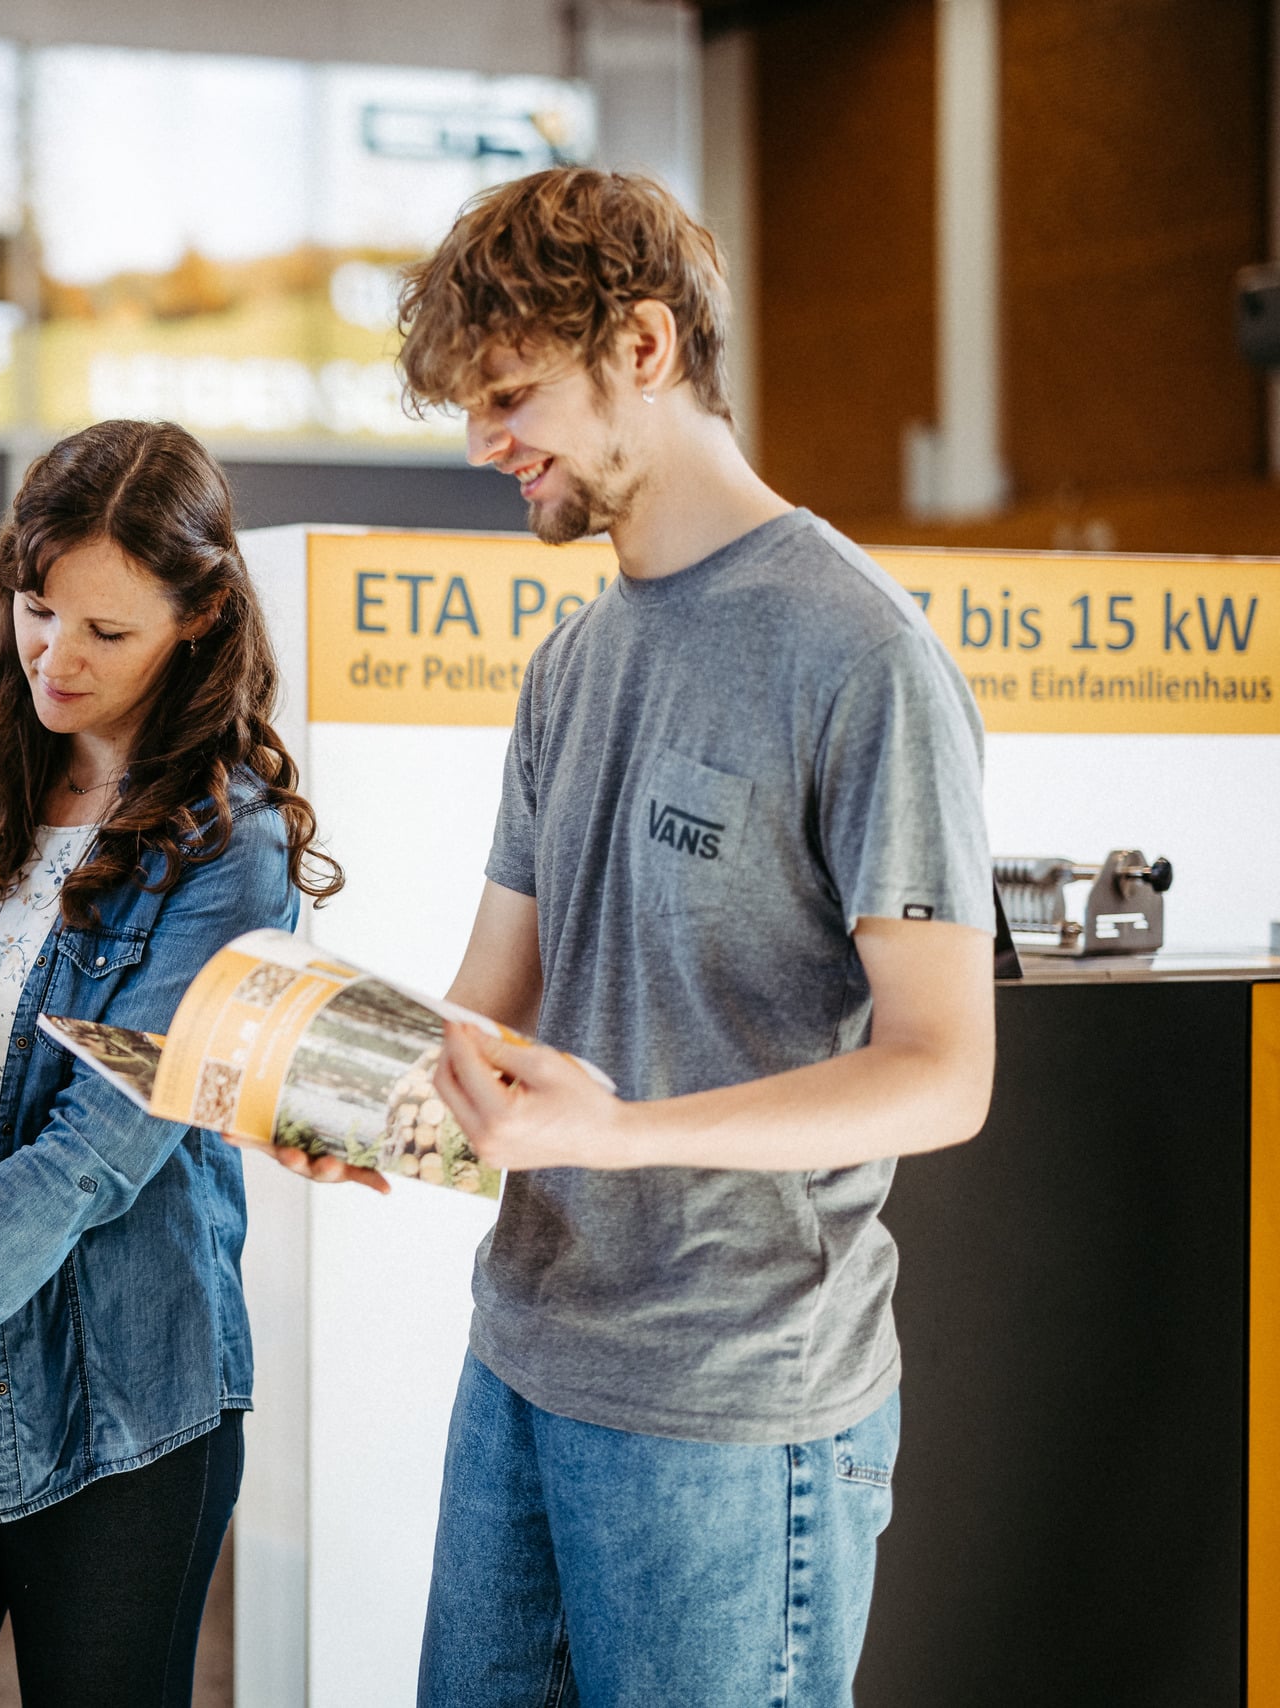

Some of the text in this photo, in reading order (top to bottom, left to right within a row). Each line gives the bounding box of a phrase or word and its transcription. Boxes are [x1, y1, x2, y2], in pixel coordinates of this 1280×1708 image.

[356, 572, 480, 636] ETA
[512, 576, 604, 637] Pe
[961, 588, 1043, 650] bis
[1070, 594, 1137, 652] 15
[1164, 591, 1259, 652] kW
[349, 653, 408, 687] der
[1030, 666, 1272, 702] Einfamilienhaus
[649, 799, 725, 860] VANS
